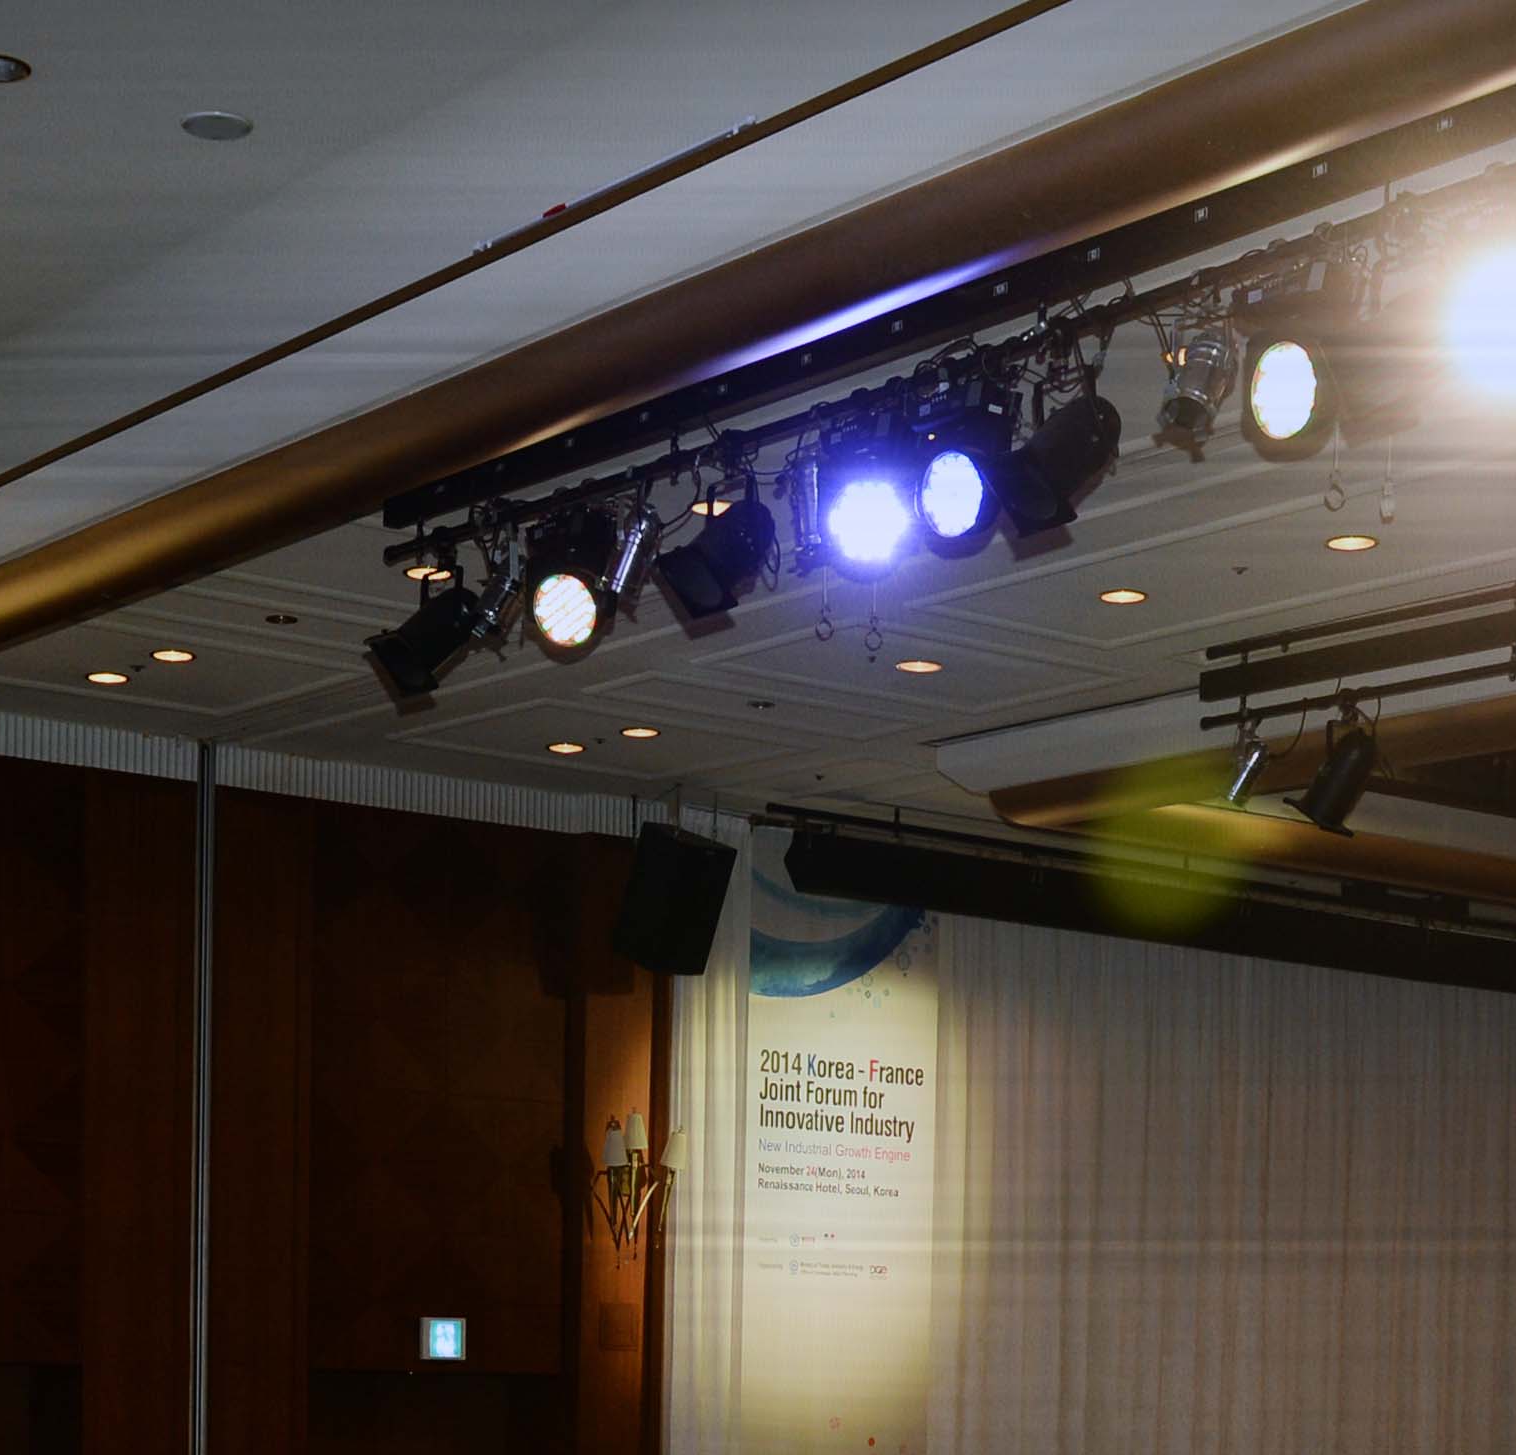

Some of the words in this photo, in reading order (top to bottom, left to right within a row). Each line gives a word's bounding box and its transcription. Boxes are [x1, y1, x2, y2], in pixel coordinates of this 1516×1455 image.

[760, 1049, 802, 1075] 2014
[807, 1054, 854, 1080] Korea
[869, 1060, 924, 1086] France
[759, 1077, 801, 1102] Joint
[806, 1081, 857, 1107] Forum
[862, 1086, 885, 1109] for
[759, 1104, 844, 1133] Innovative
[850, 1112, 914, 1143] Industry
[758, 1138, 782, 1152] New
[785, 1141, 832, 1156] Industrial
[835, 1144, 872, 1159] Growth
[874, 1146, 911, 1163] Engine
[758, 1162, 804, 1177] November
[846, 1169, 865, 1179] 2014
[758, 1178, 813, 1193] Renaissance
[873, 1186, 899, 1198] Korea
